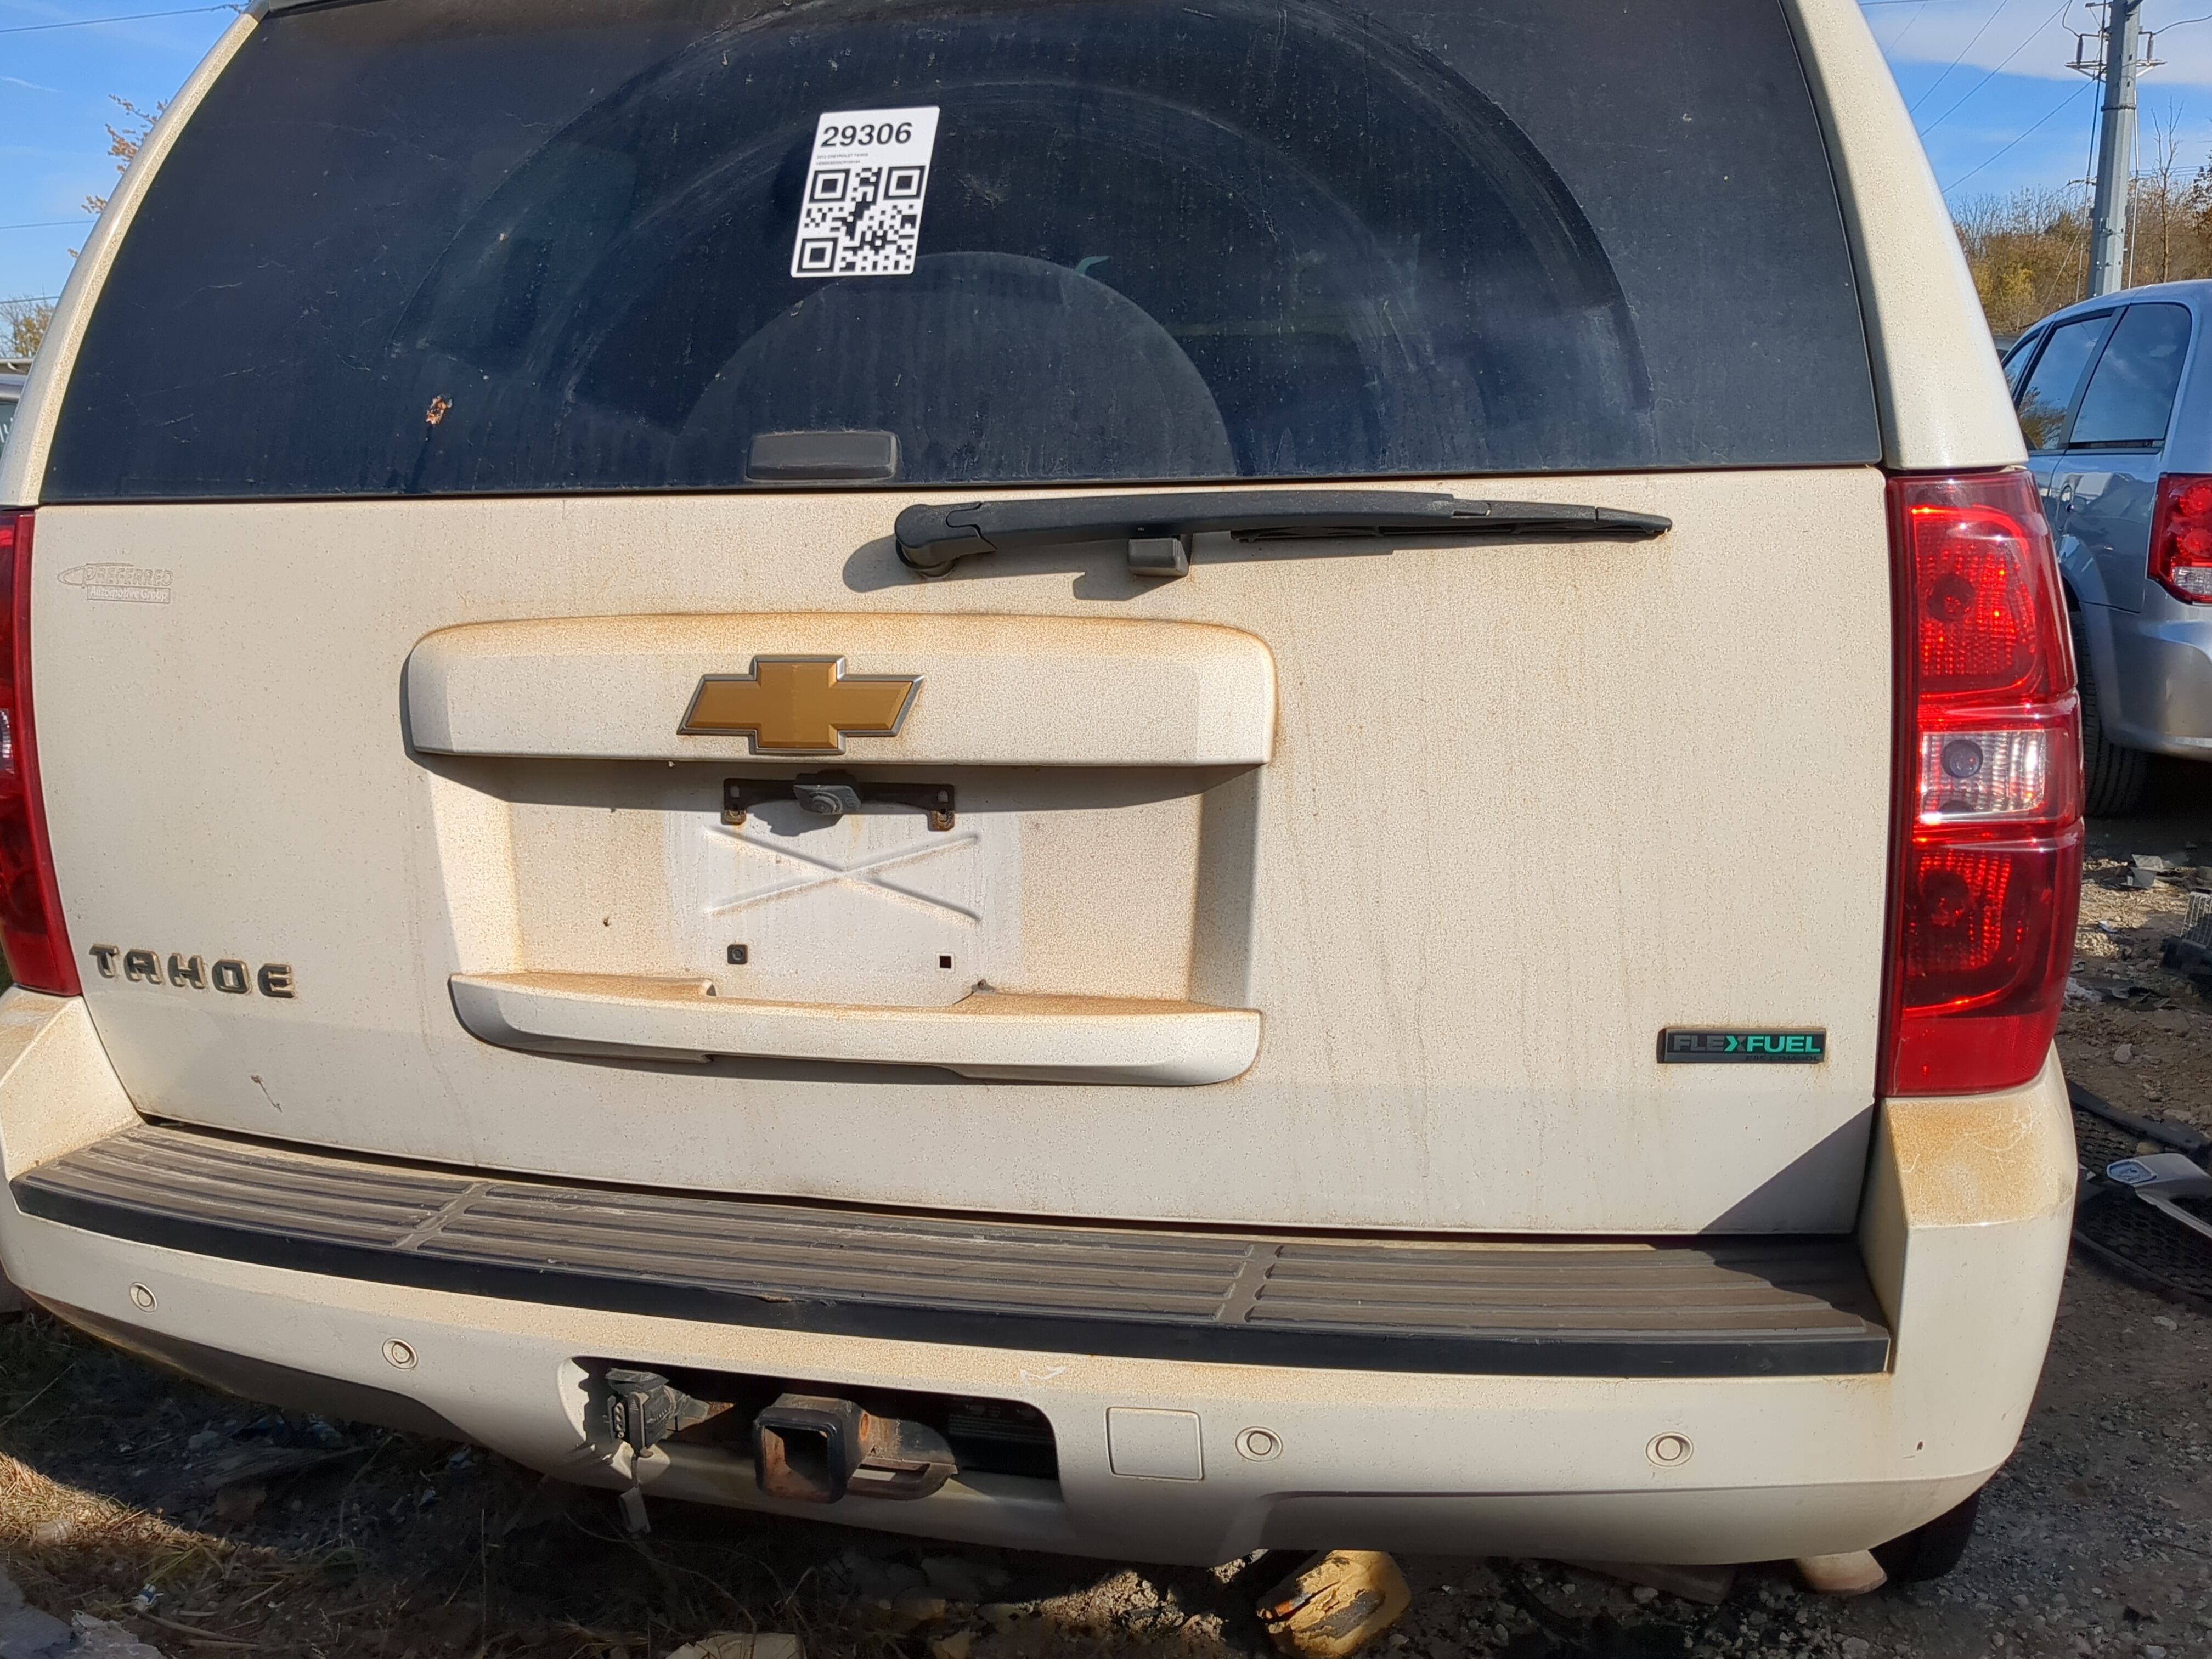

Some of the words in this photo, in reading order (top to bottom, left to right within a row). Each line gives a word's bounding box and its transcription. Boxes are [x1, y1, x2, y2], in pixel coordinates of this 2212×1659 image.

[820, 122, 913, 148] 29306
[82, 567, 173, 587] PREFERRED
[90, 588, 138, 599] Automotive
[141, 590, 168, 602] Group
[89, 943, 296, 998] TAHOE
